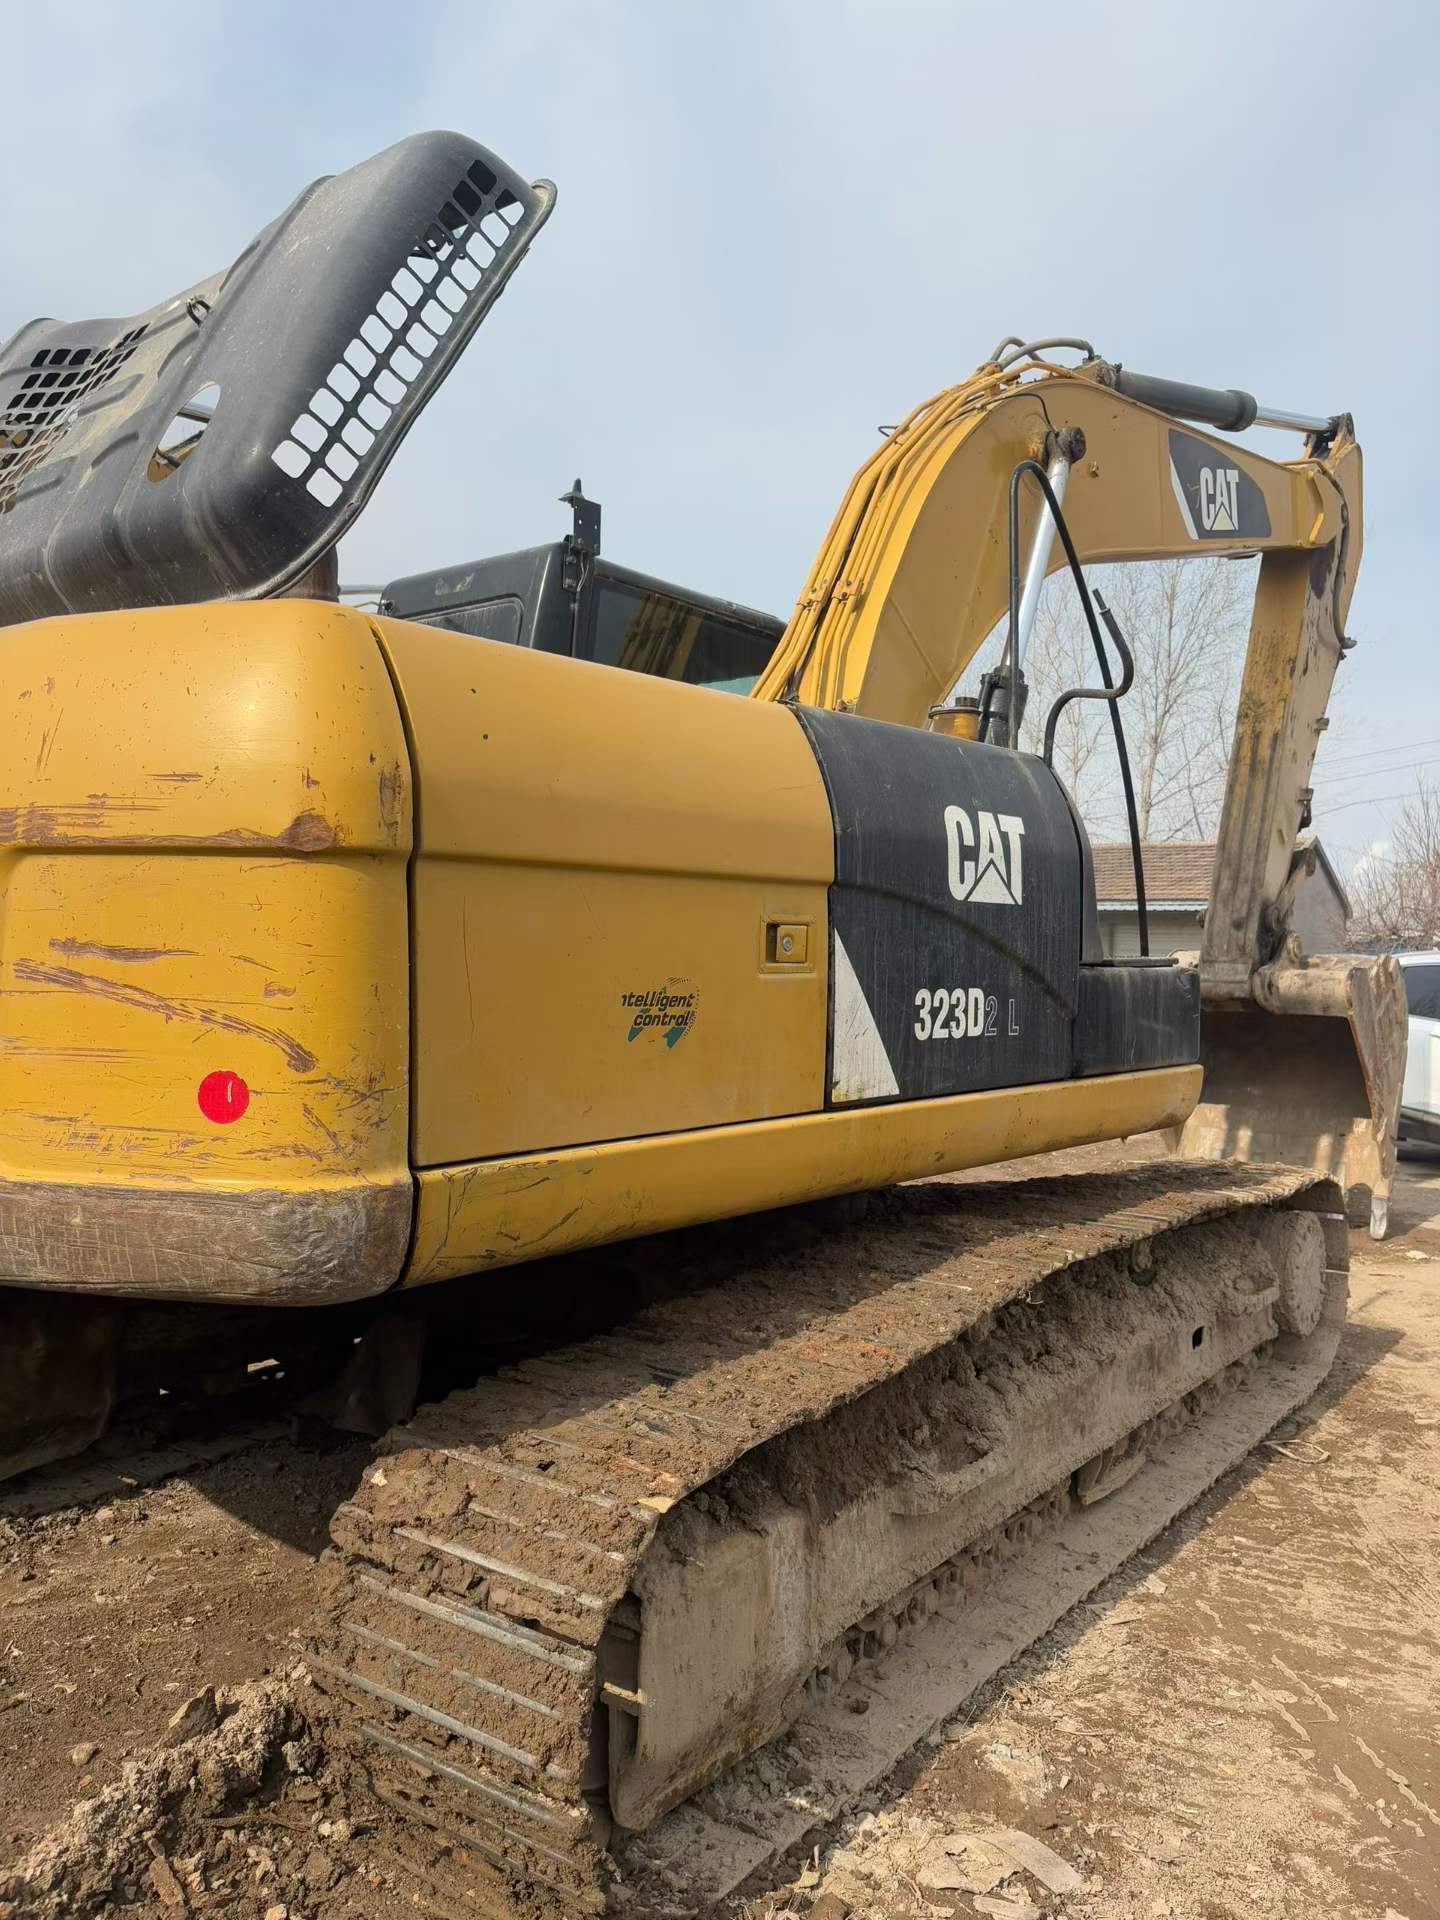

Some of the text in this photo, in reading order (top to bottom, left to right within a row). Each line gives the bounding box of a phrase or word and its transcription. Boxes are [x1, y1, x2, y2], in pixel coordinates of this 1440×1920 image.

[1199, 467, 1240, 531] CAT
[944, 804, 1025, 905] CAT
[633, 1011, 690, 1027] control
